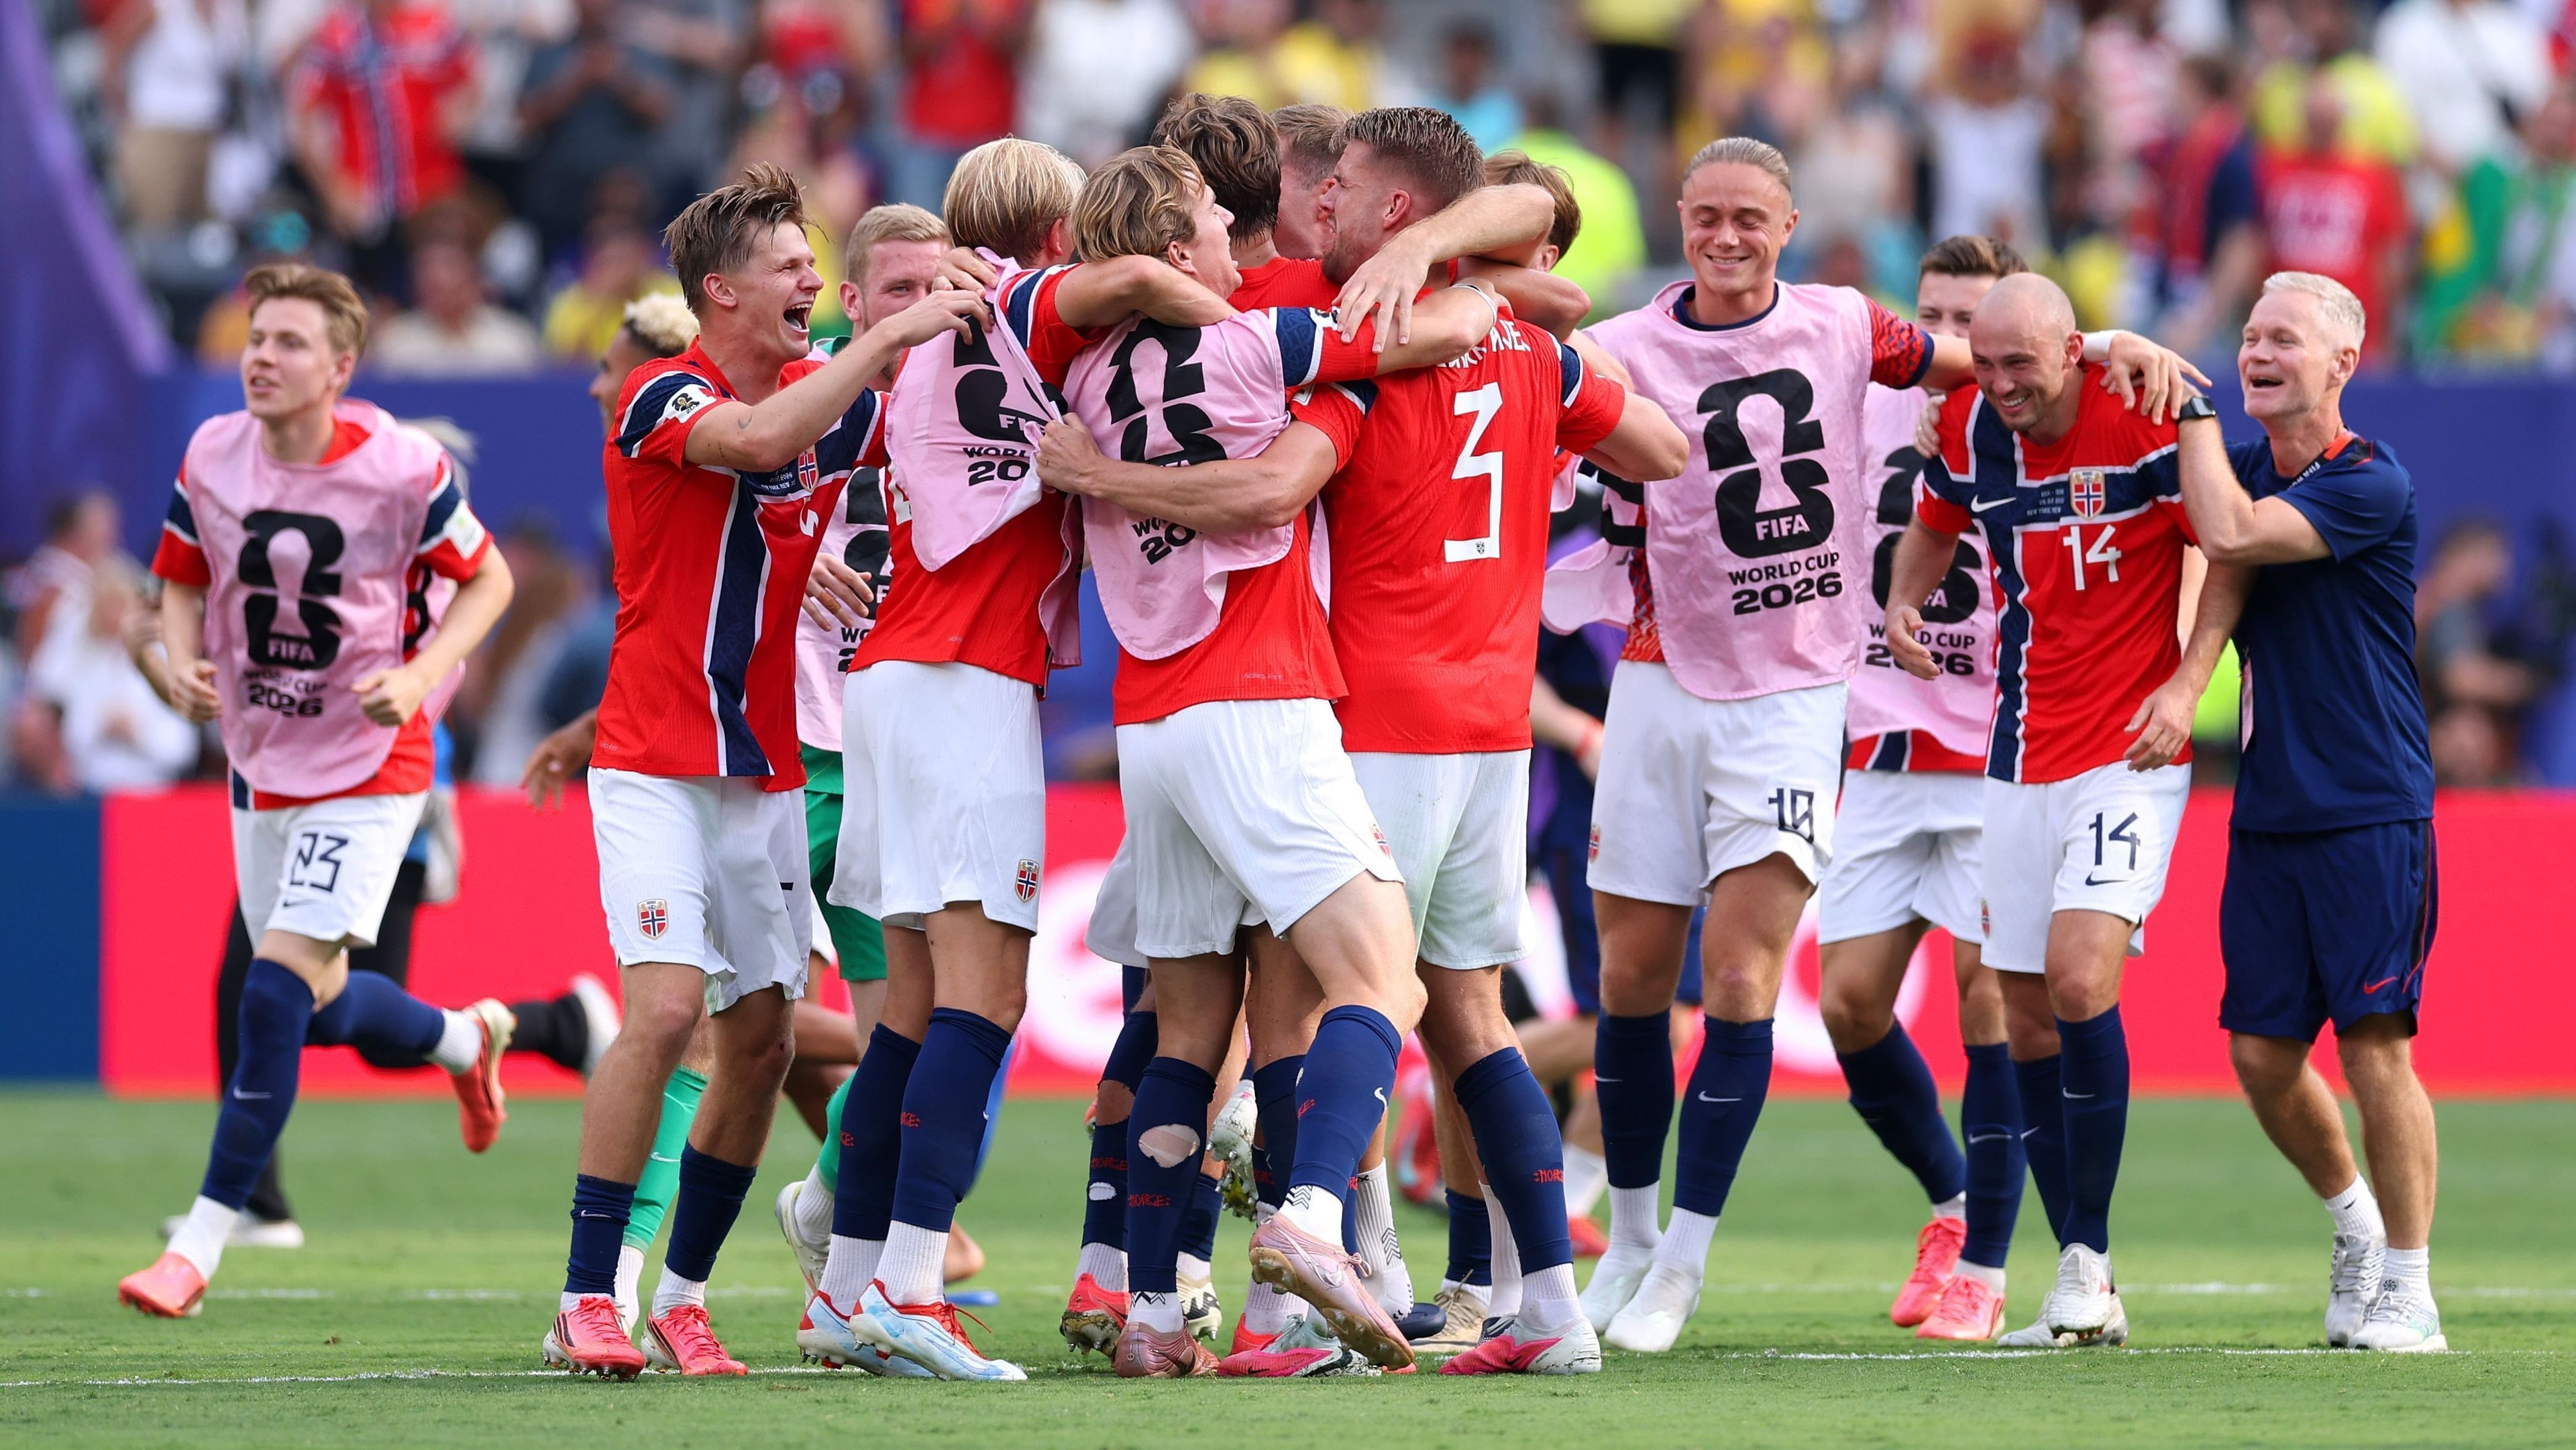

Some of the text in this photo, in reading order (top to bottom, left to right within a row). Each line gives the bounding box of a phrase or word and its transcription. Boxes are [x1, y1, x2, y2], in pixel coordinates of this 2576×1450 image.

[963, 447, 1027, 458] WORL
[967, 459, 1030, 486] 20
[1444, 382, 1503, 563] 3
[1140, 522, 1196, 565] 20
[1755, 514, 1811, 541] FIFA
[1728, 552, 1839, 585] WORLD CUP
[2062, 524, 2122, 591] 14
[1731, 572, 1843, 616] 2026
[268, 638, 316, 663] FIFA
[1936, 632, 1976, 649] CUP
[2088, 812, 2141, 871] 14
[290, 833, 349, 893] 23
